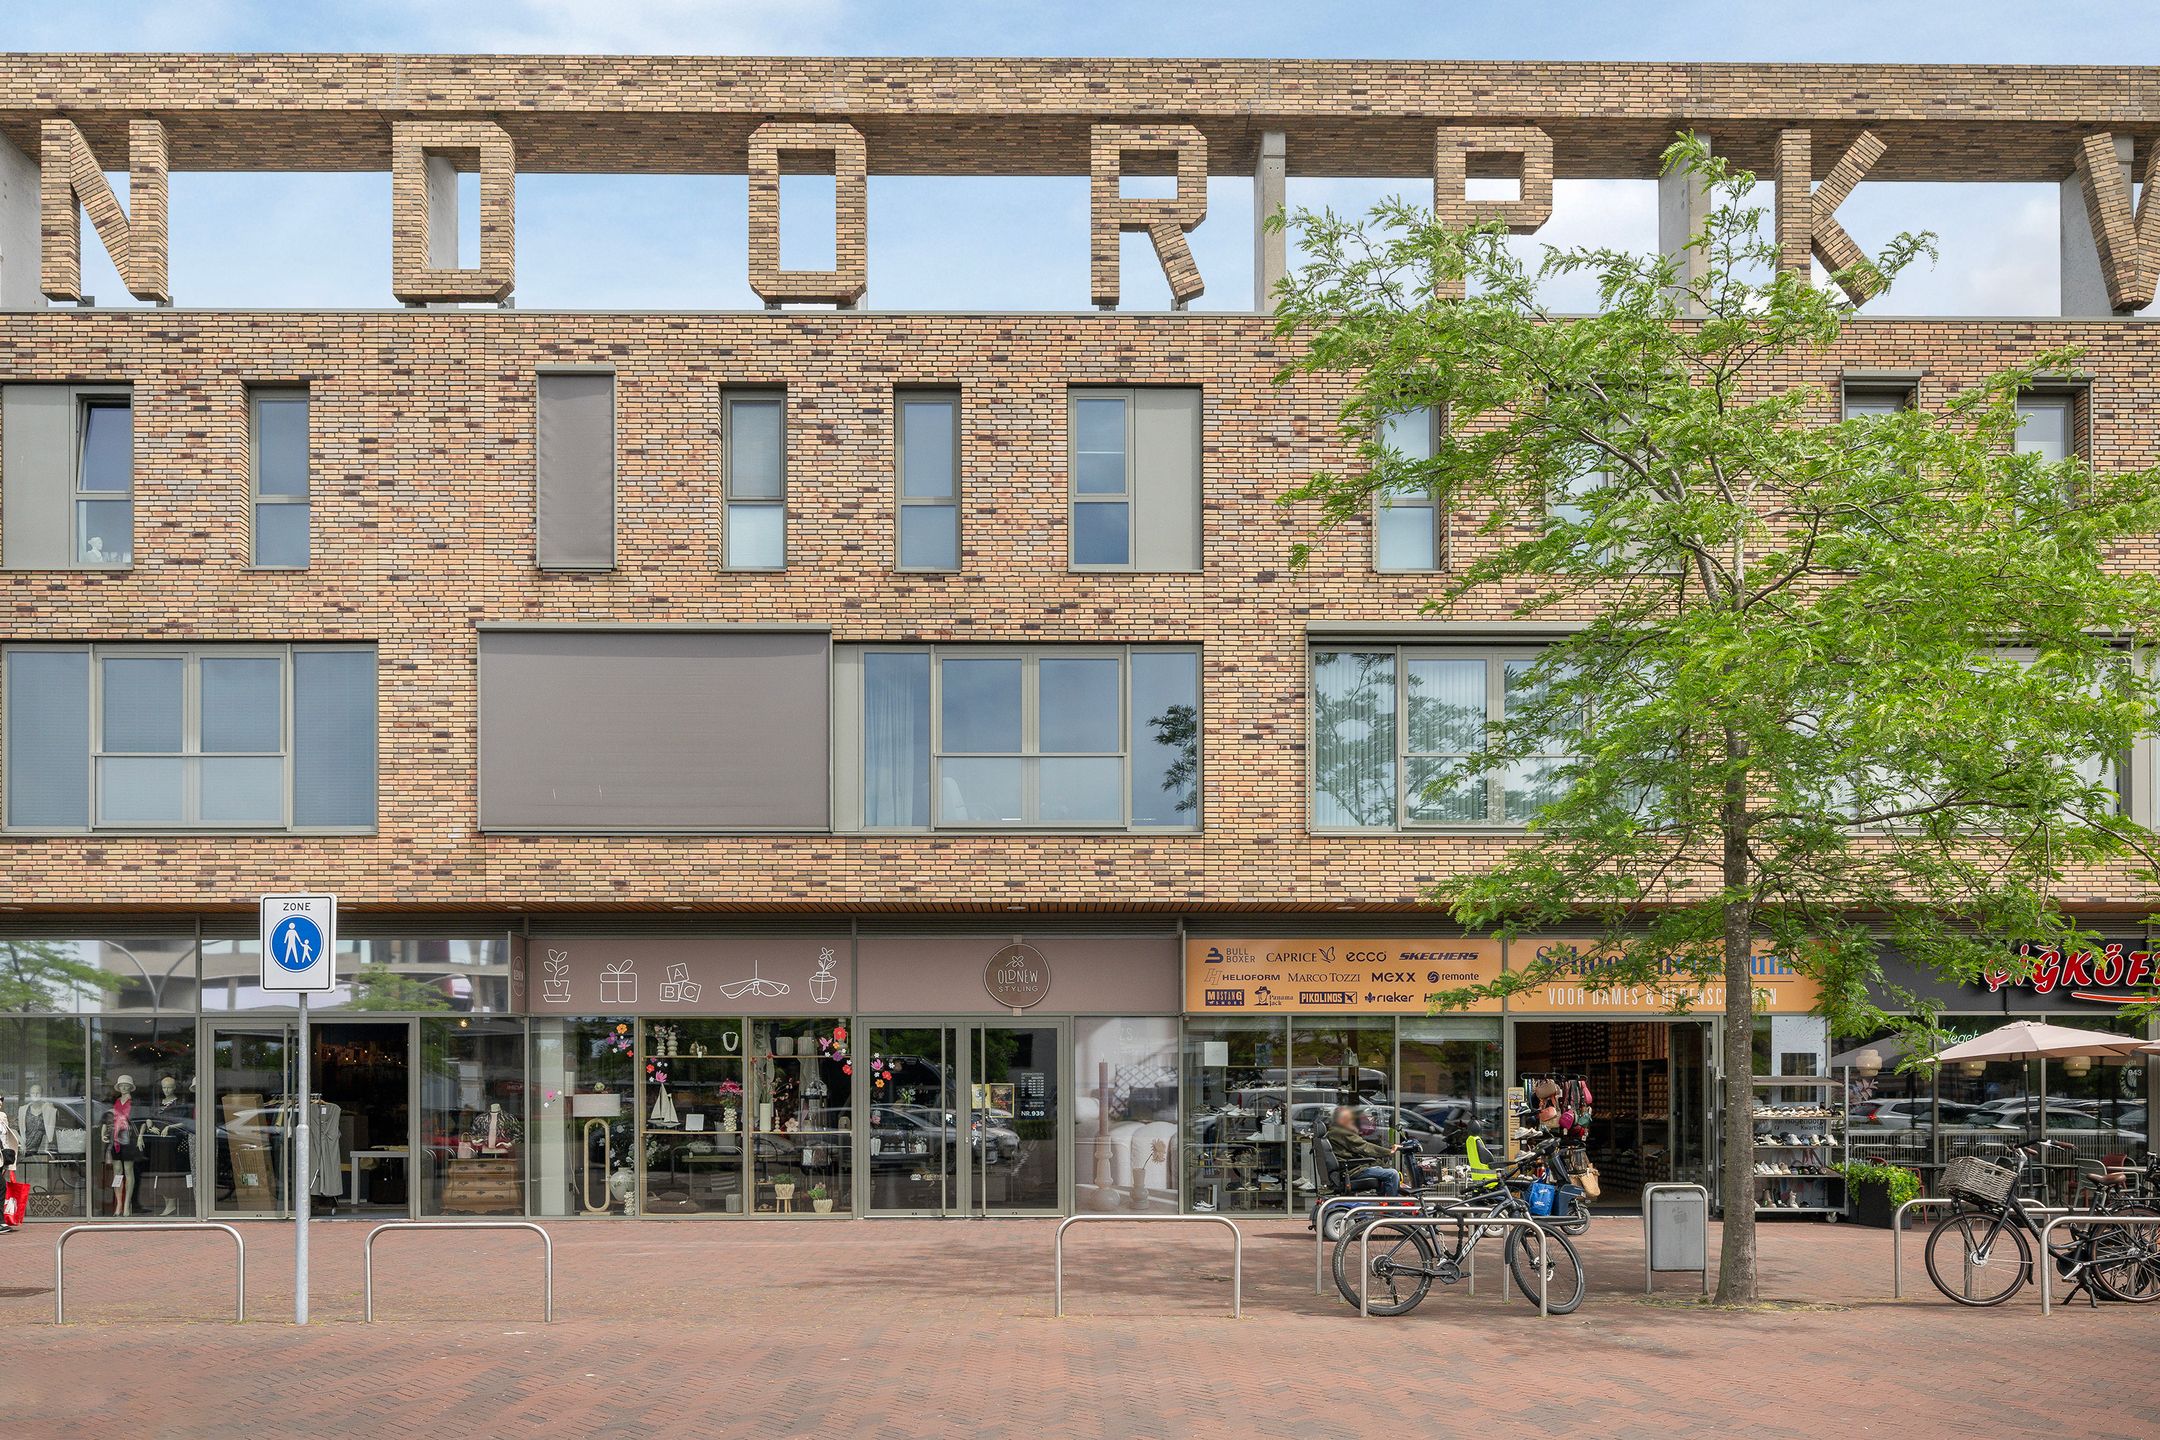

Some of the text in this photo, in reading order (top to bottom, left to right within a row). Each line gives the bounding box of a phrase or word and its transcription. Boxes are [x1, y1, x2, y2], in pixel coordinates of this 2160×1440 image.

[282, 902, 311, 911] ZONE
[1226, 947, 1249, 956] BULL
[1399, 952, 1480, 960] SKECHERS
[1266, 952, 1318, 962] CAPRICE
[1345, 951, 1387, 962] ecco
[1288, 973, 1361, 982] MARCO TOZZI
[1441, 972, 1480, 980] remonte
[1301, 993, 1343, 1003] PIKOLINOS
[1377, 992, 1415, 1002] rieker
[1548, 988, 1585, 1005] VOOR
[1592, 988, 1639, 1005] DAMES
[1645, 988, 1654, 1005] &
